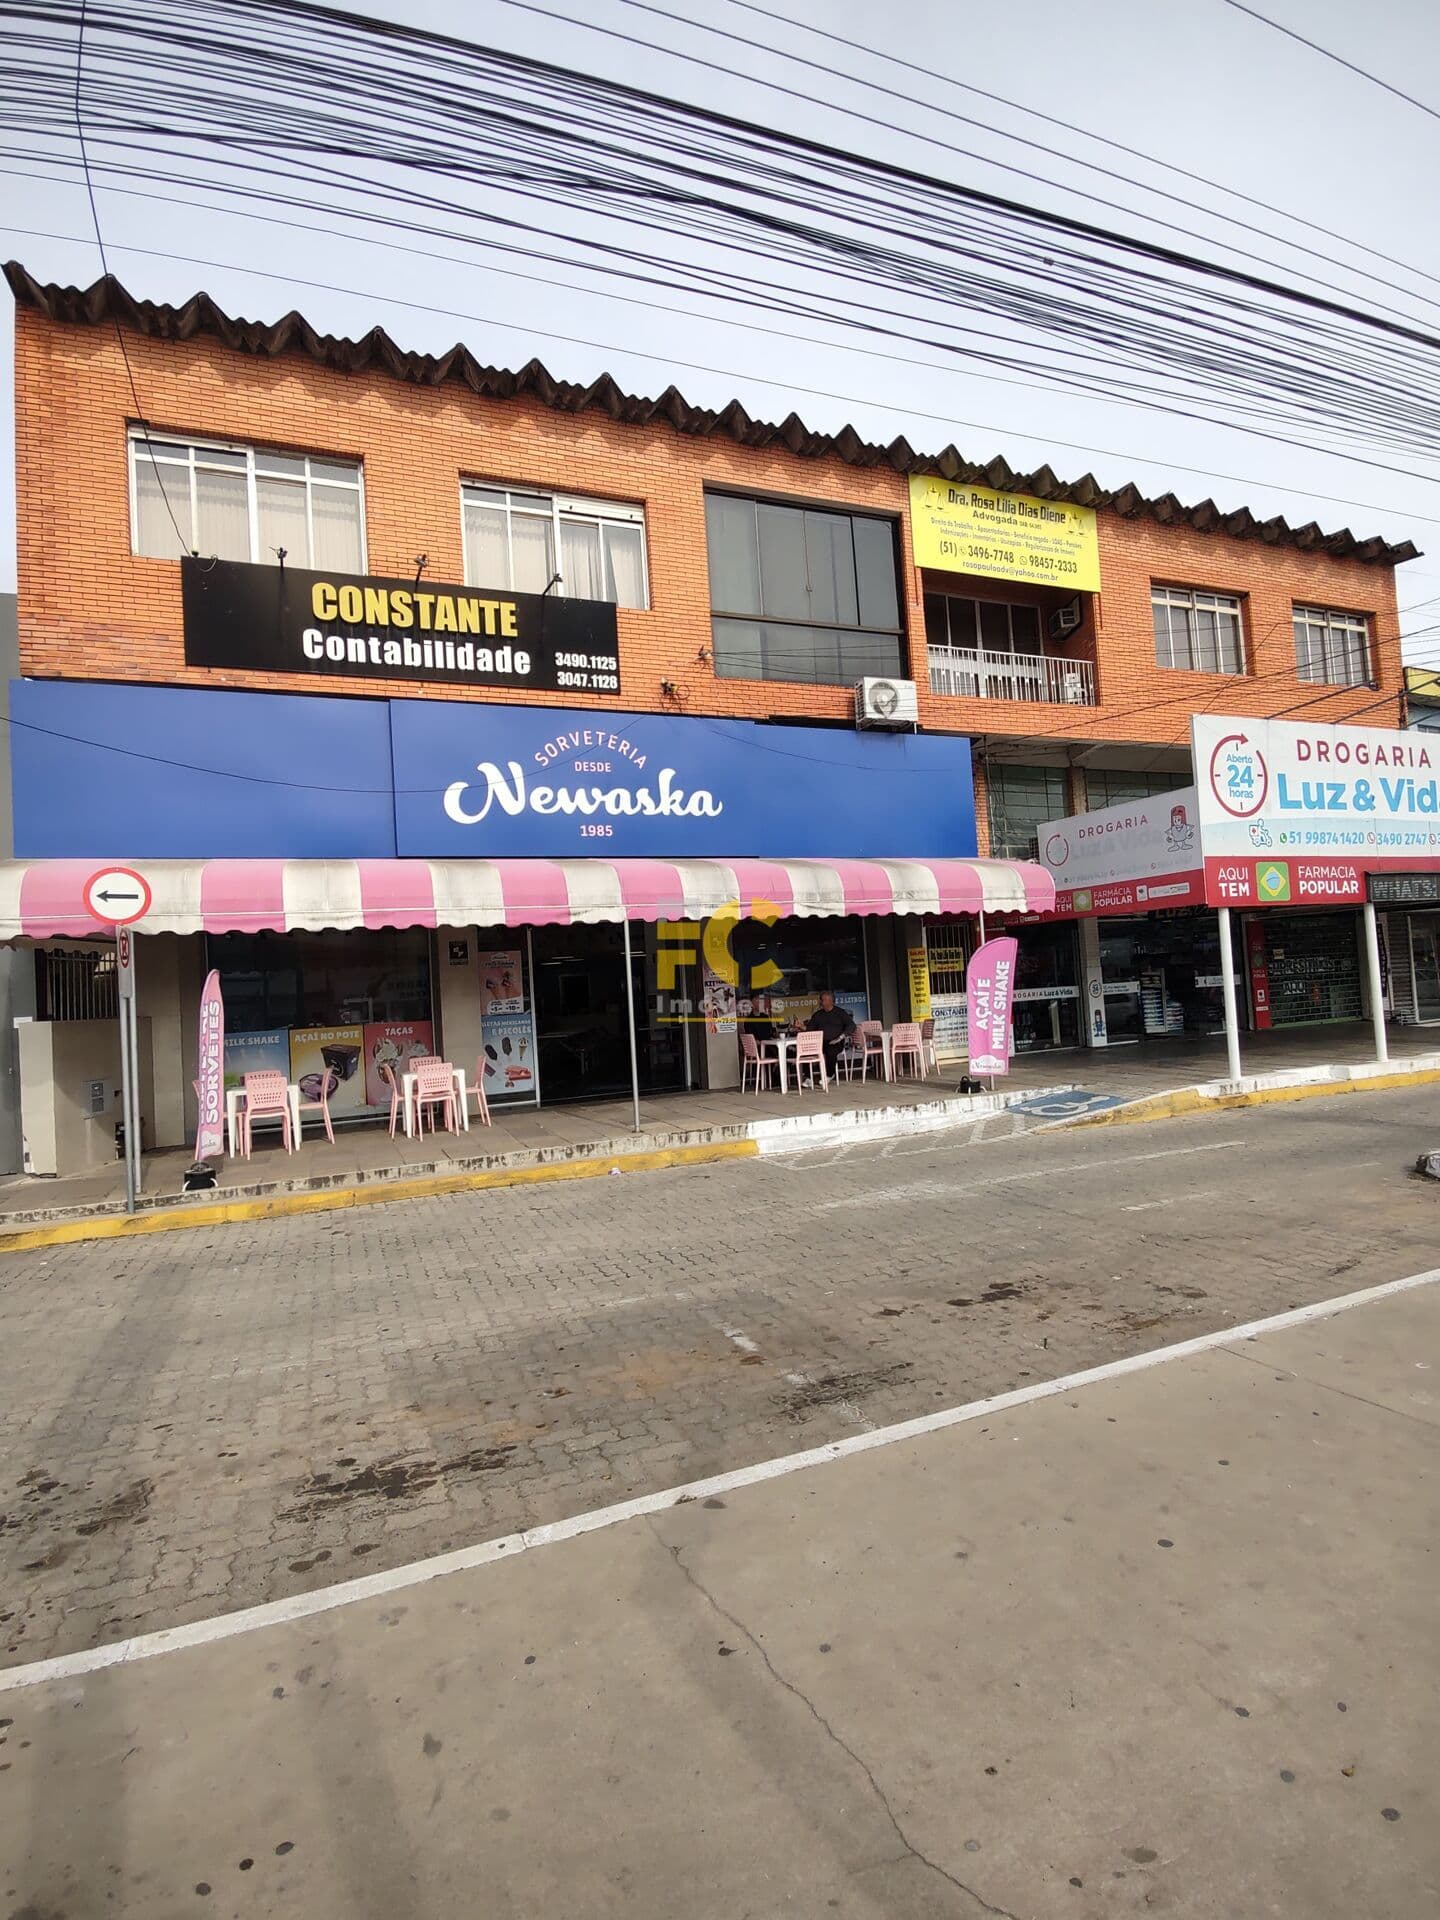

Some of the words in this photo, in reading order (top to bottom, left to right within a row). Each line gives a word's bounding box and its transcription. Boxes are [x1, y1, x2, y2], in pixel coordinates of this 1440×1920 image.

[948, 488, 969, 506] Dra.
[970, 492, 995, 511] Rosa
[1018, 501, 1038, 519] Dias
[1040, 506, 1066, 524] Diene
[972, 509, 1018, 526] Advogada
[940, 540, 958, 558] (51)
[968, 545, 1014, 564] 3496-7748
[1029, 555, 1078, 574] 98457-2333
[310, 581, 519, 637] CONSTANTE
[302, 628, 531, 675] Contabilidade
[555, 652, 617, 671] 3490.1125
[557, 671, 618, 689] 3047.1128
[534, 730, 647, 769] SORVETERIA
[1296, 739, 1432, 768] DROGARIA
[574, 761, 611, 773] DESDE
[1226, 753, 1253, 764] Aberto
[1227, 764, 1254, 788] 24
[443, 761, 723, 825] Newaska
[1229, 787, 1254, 799] horas
[1277, 773, 1347, 811] Luz
[1379, 777, 1440, 813] Vid
[580, 825, 613, 838] 1985
[1078, 814, 1149, 839] DROGARIA
[1289, 831, 1302, 844] 51
[1305, 831, 1365, 845] 998741420
[1377, 832, 1402, 846] 3490
[1404, 833, 1427, 846] 2747
[1218, 867, 1249, 881] AQUI
[1219, 882, 1250, 898] TEM
[1299, 880, 1359, 895] POPULAR
[1056, 903, 1072, 913] TEM
[1094, 895, 1133, 908] POPULAR
[977, 978, 990, 988] E
[993, 961, 1010, 1011] SHAKE
[1013, 991, 1042, 999] ROGARIA
[973, 990, 992, 1030] AÇAÍ
[294, 1031, 318, 1043] AÇAÍ
[320, 1032, 334, 1040] NO
[336, 1030, 359, 1039] POTE
[384, 1026, 414, 1036] TAÇAS
[992, 1015, 1006, 1050] MILK
[248, 1035, 280, 1045] SHAKE
[206, 1001, 220, 1125] SORVETES
